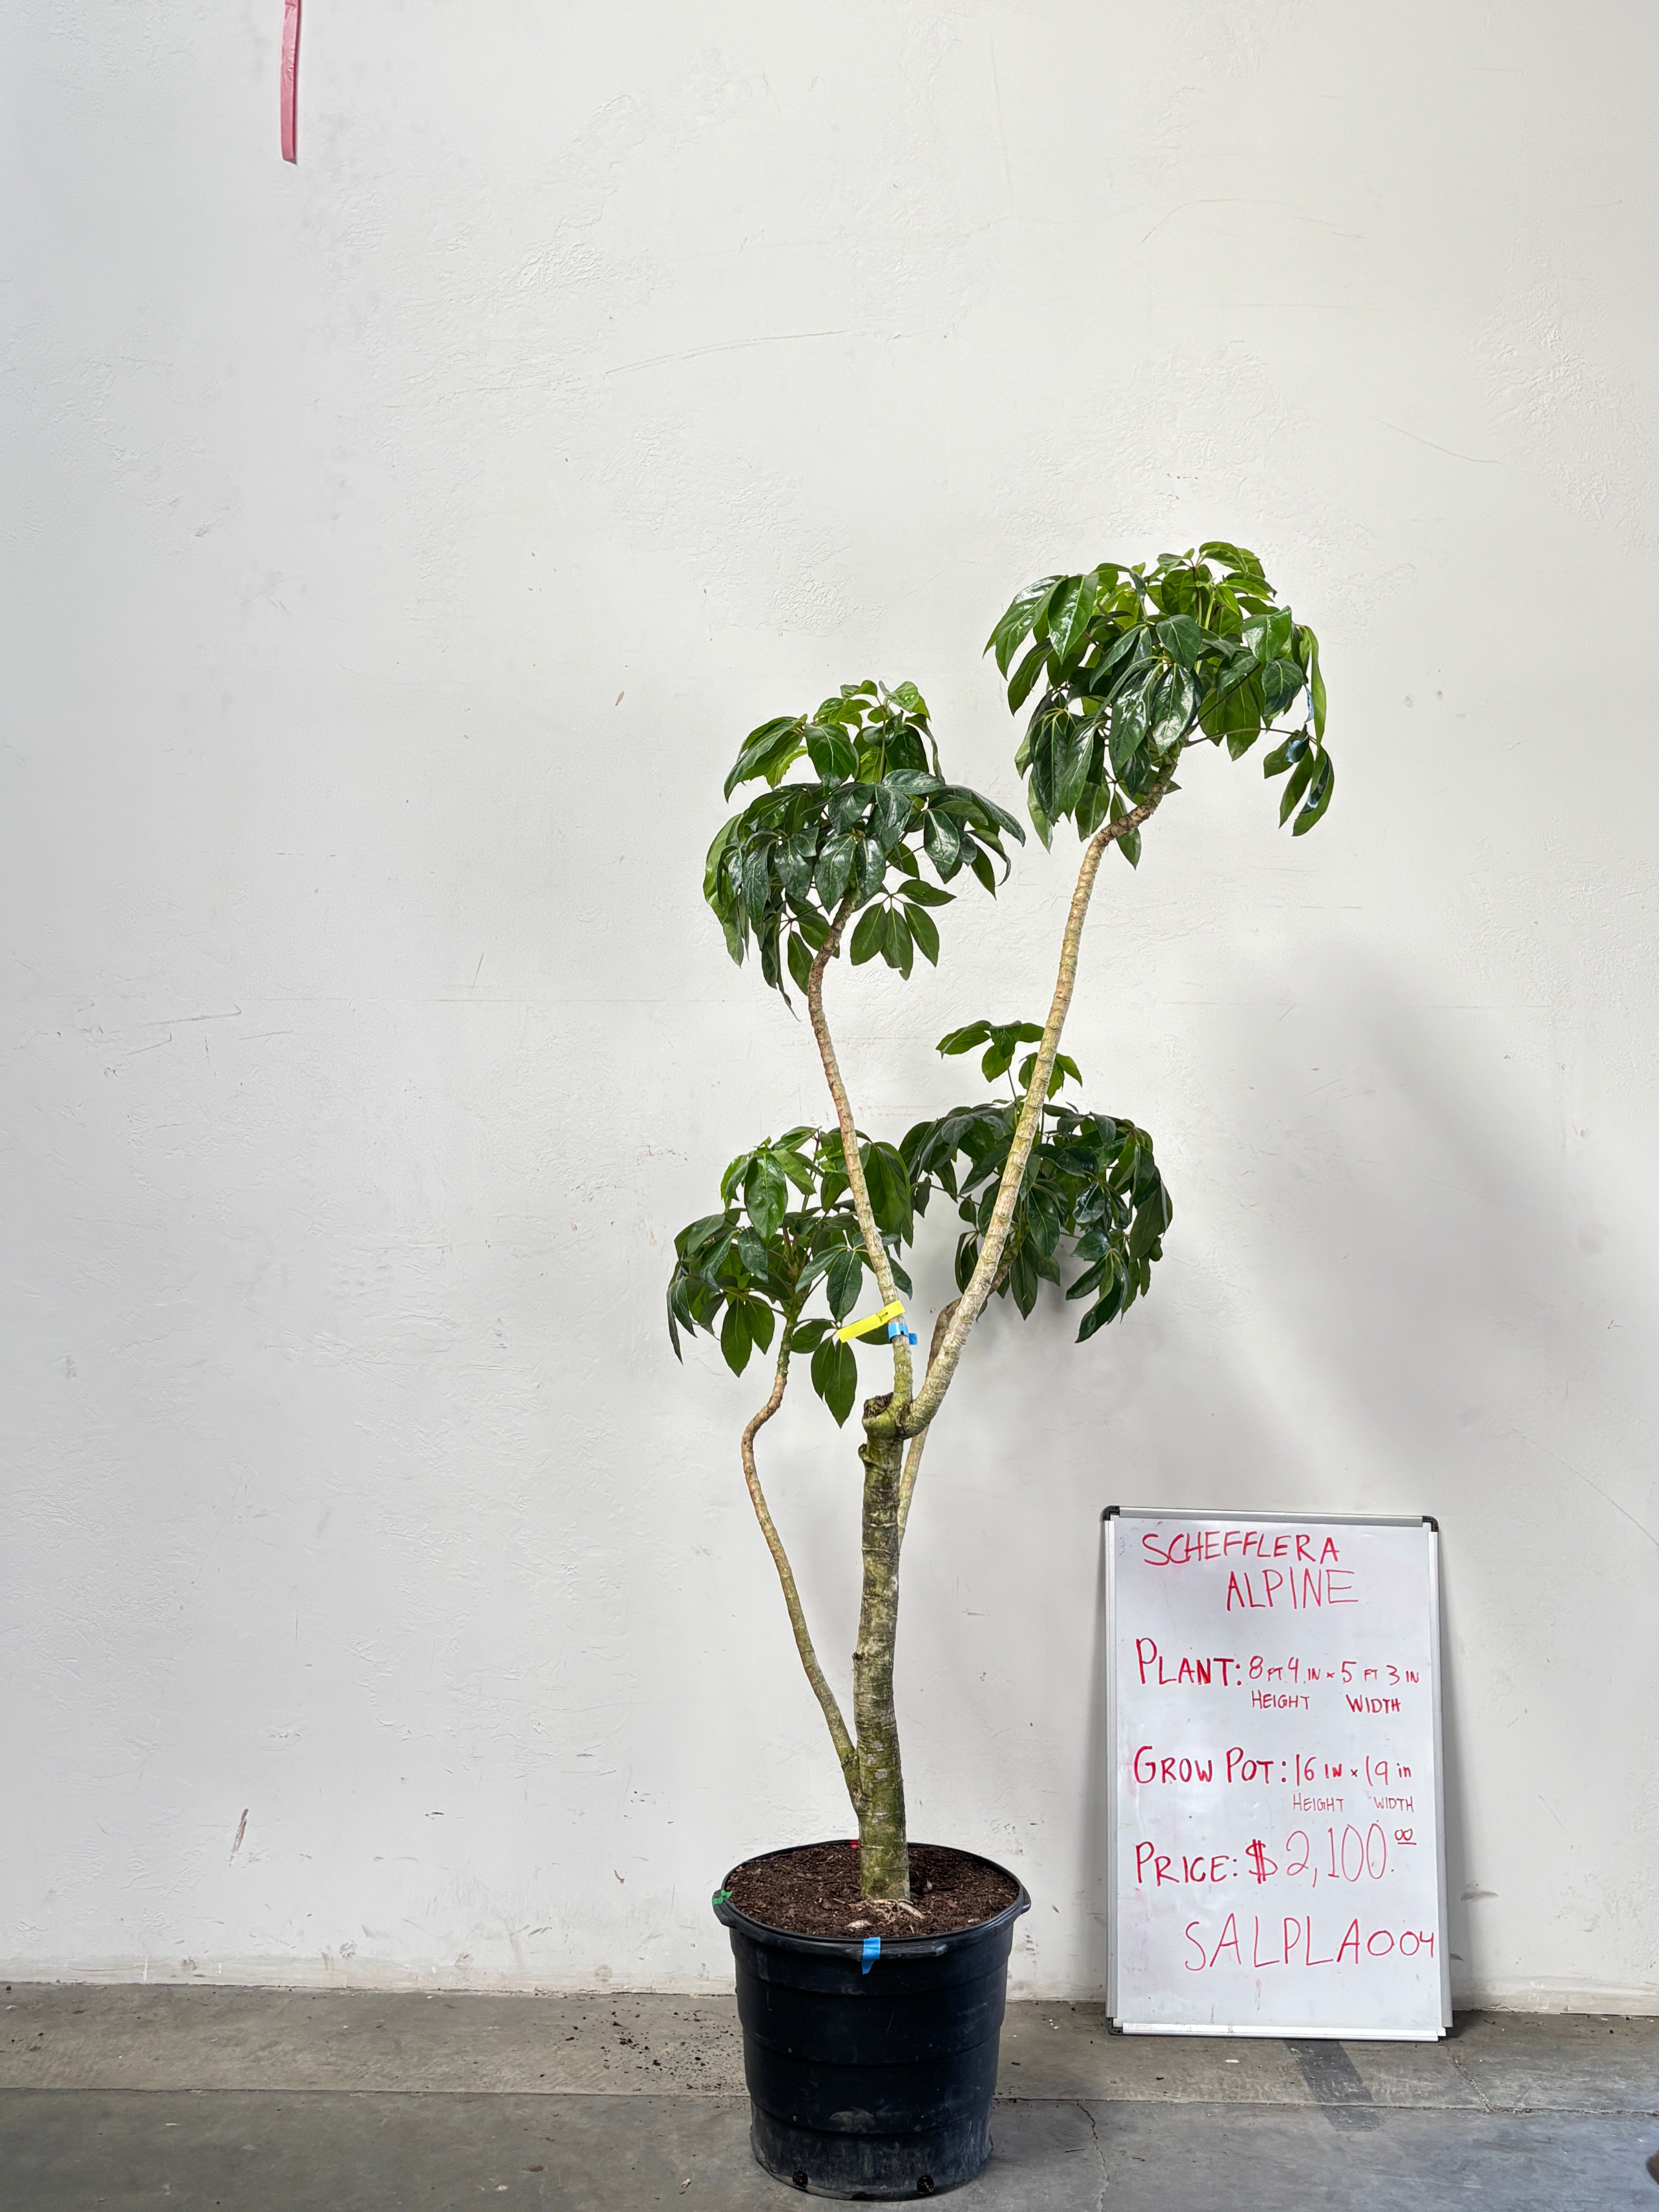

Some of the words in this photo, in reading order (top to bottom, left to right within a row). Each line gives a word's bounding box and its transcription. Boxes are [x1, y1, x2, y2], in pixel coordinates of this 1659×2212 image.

[1142, 1531, 1339, 1566] SCHEFFLERA
[1226, 1567, 1358, 1611] ALPINE
[1135, 1638, 1242, 1686] PLANT:
[1251, 1690, 1310, 1709] HEIGHT
[1346, 1695, 1400, 1713] WIDTH
[1133, 1746, 1212, 1784] GROW
[1293, 1793, 1344, 1813] HEIGHT
[1373, 1796, 1413, 1813] WIDTH
[1135, 1841, 1237, 1887] PRICE:
[1185, 1913, 1434, 1971] SALPLA004
